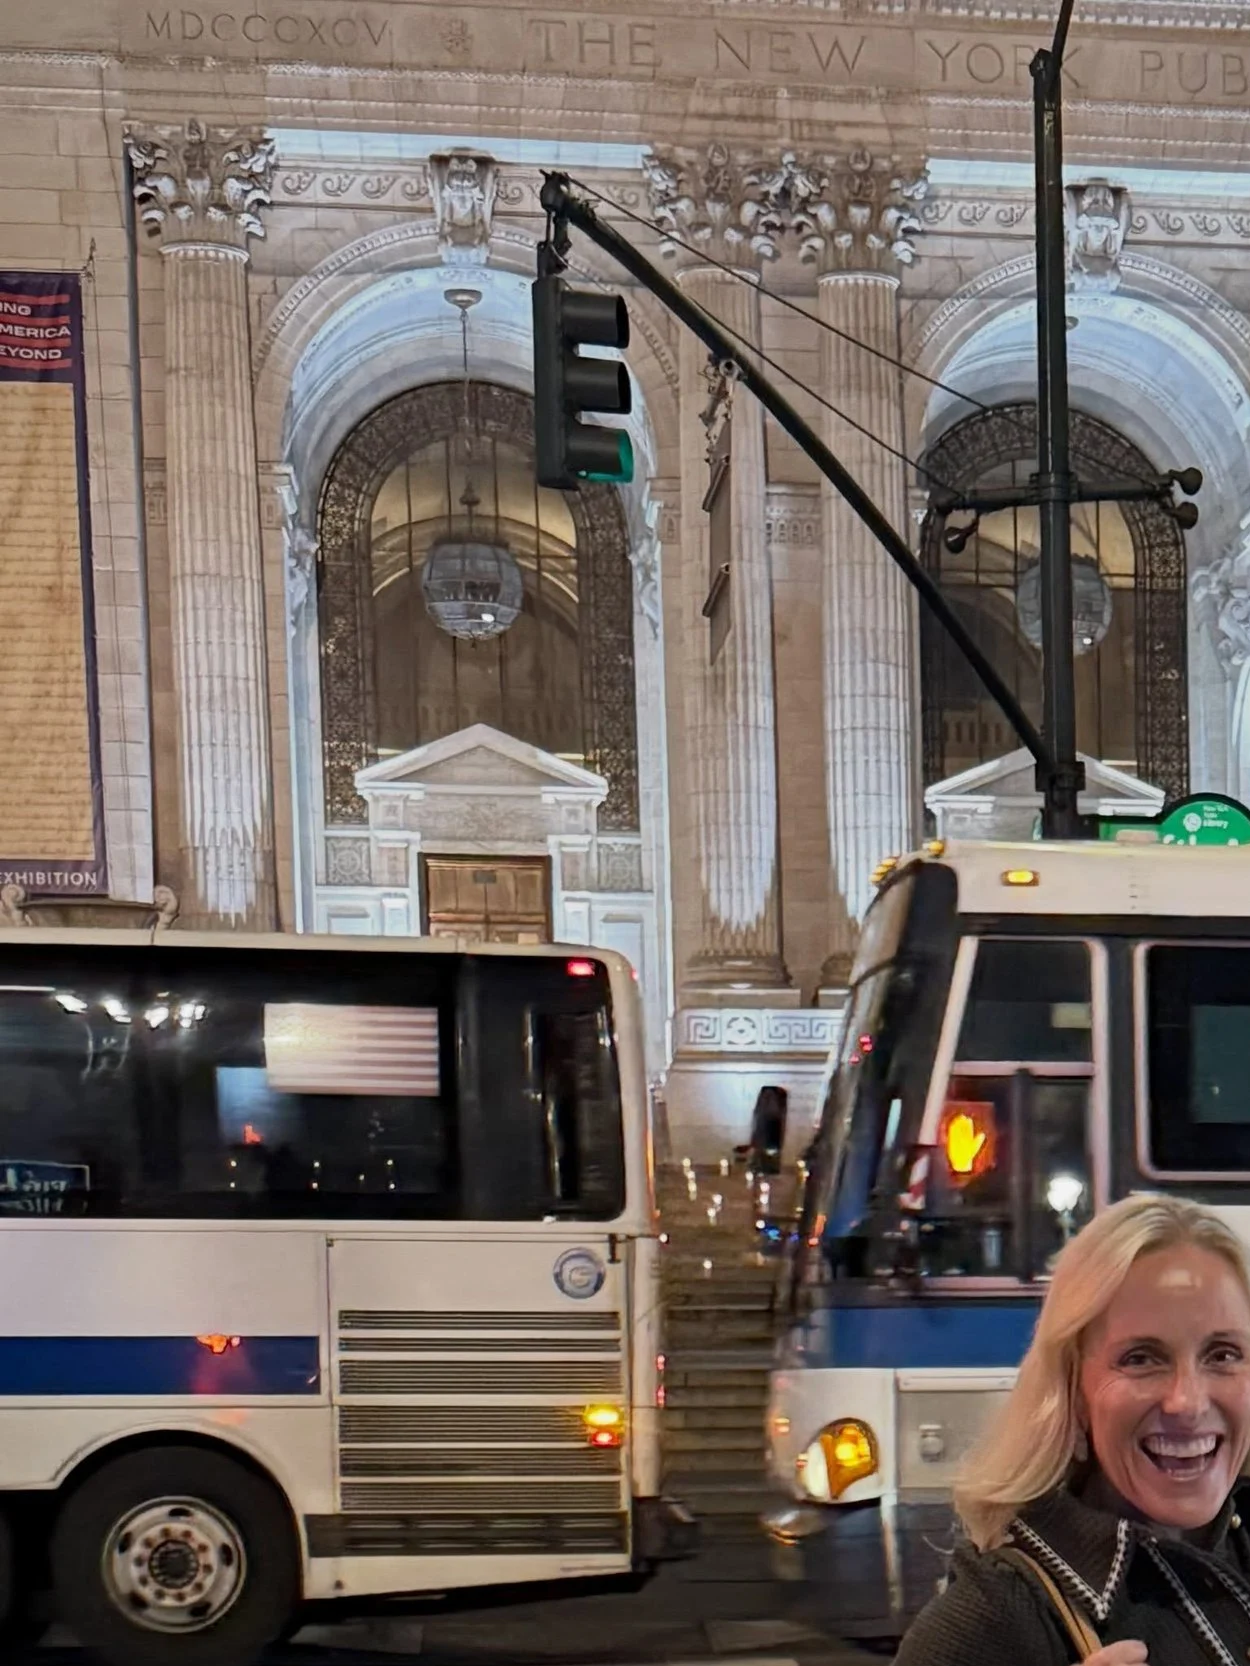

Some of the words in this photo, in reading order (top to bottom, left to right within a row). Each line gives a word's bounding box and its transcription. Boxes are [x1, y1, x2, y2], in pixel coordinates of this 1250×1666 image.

[145, 10, 389, 46] MDCCCXCV
[527, 19, 661, 67] THE
[712, 27, 867, 75] NEW
